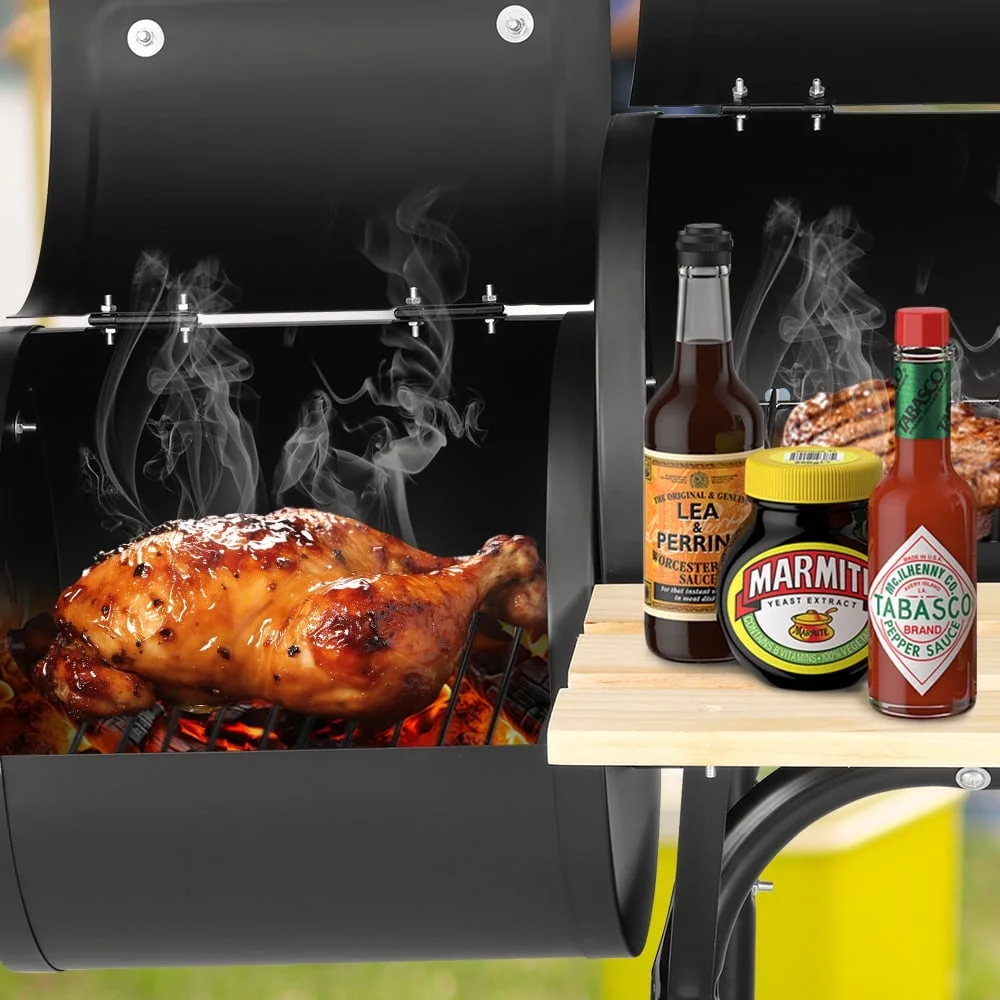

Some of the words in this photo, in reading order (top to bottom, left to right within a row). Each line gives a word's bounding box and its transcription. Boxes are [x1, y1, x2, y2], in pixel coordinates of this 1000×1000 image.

[897, 367, 944, 434] TABASCO
[667, 491, 706, 501] ORIGINAL
[708, 491, 716, 499] &
[677, 502, 719, 520] LEA
[692, 521, 703, 534] &
[657, 532, 731, 552] PERRIN
[652, 549, 719, 573] WORCESTER
[767, 597, 801, 608] YEAST
[807, 596, 857, 609] EXTRACT
[873, 592, 972, 621] TABASCO
[884, 619, 920, 657] PEPPER
[926, 620, 960, 657] SAUCE
[903, 624, 942, 635] BRAND
